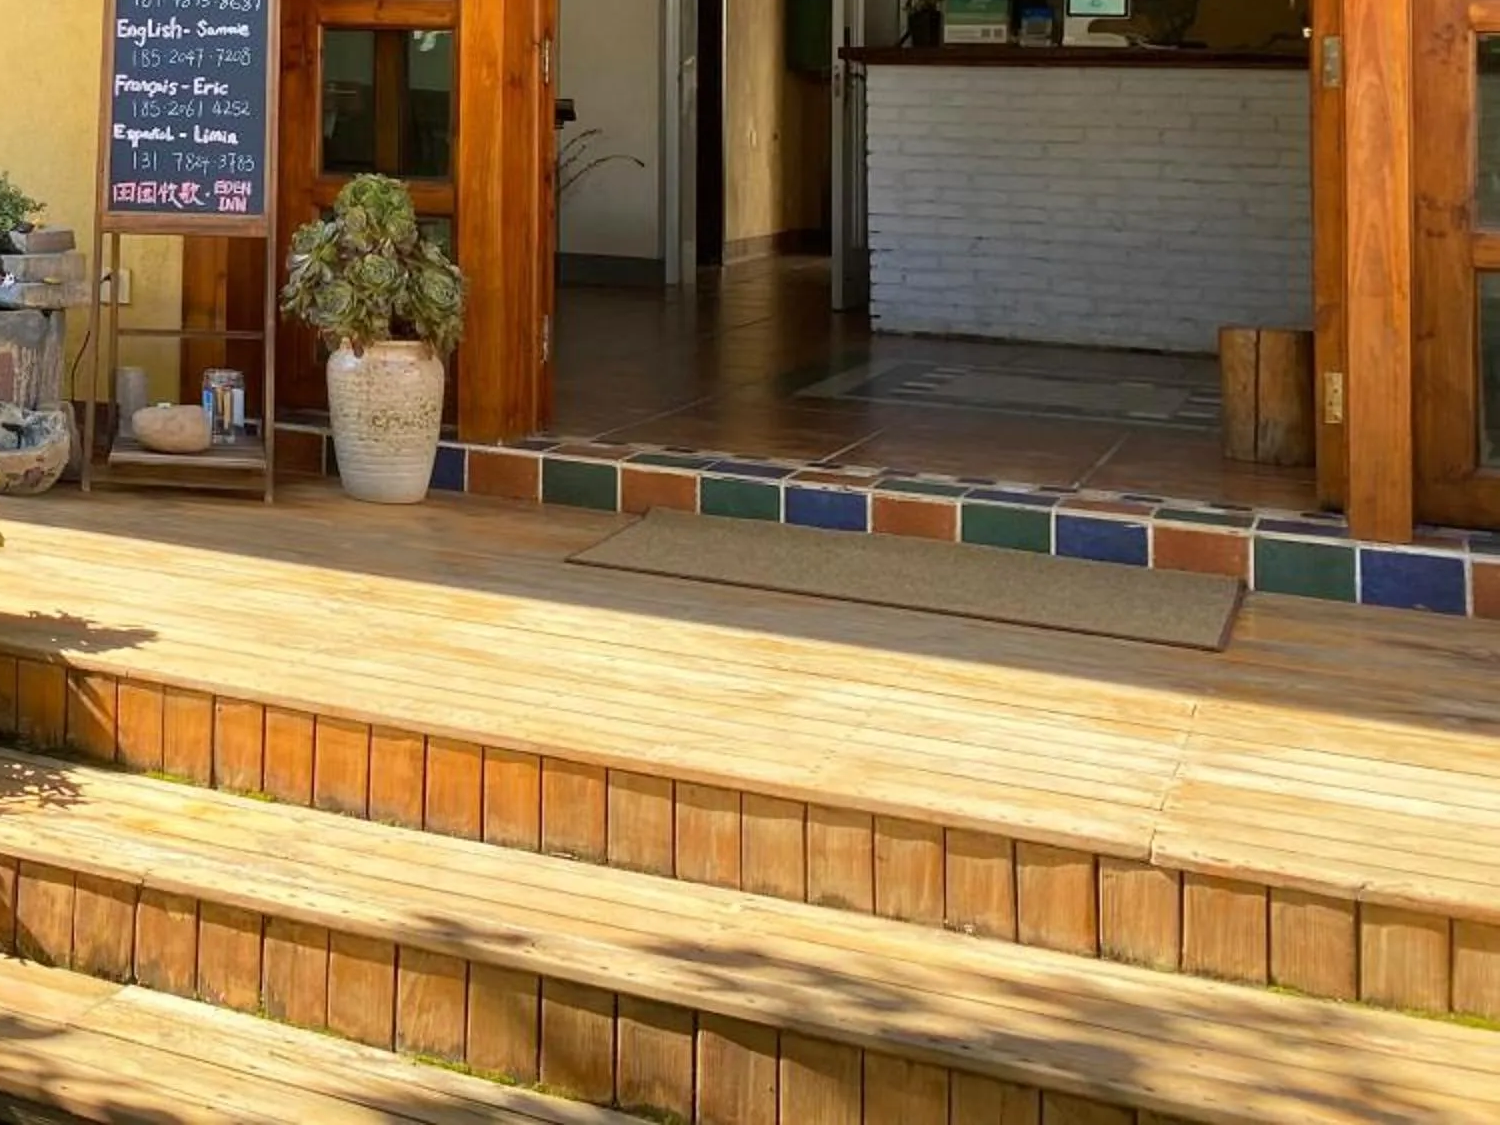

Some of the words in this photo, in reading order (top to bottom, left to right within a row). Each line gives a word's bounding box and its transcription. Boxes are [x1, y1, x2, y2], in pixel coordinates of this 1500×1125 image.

[193, 77, 229, 95] Eric
[214, 180, 253, 196] EDEN
[218, 197, 248, 212] INN
